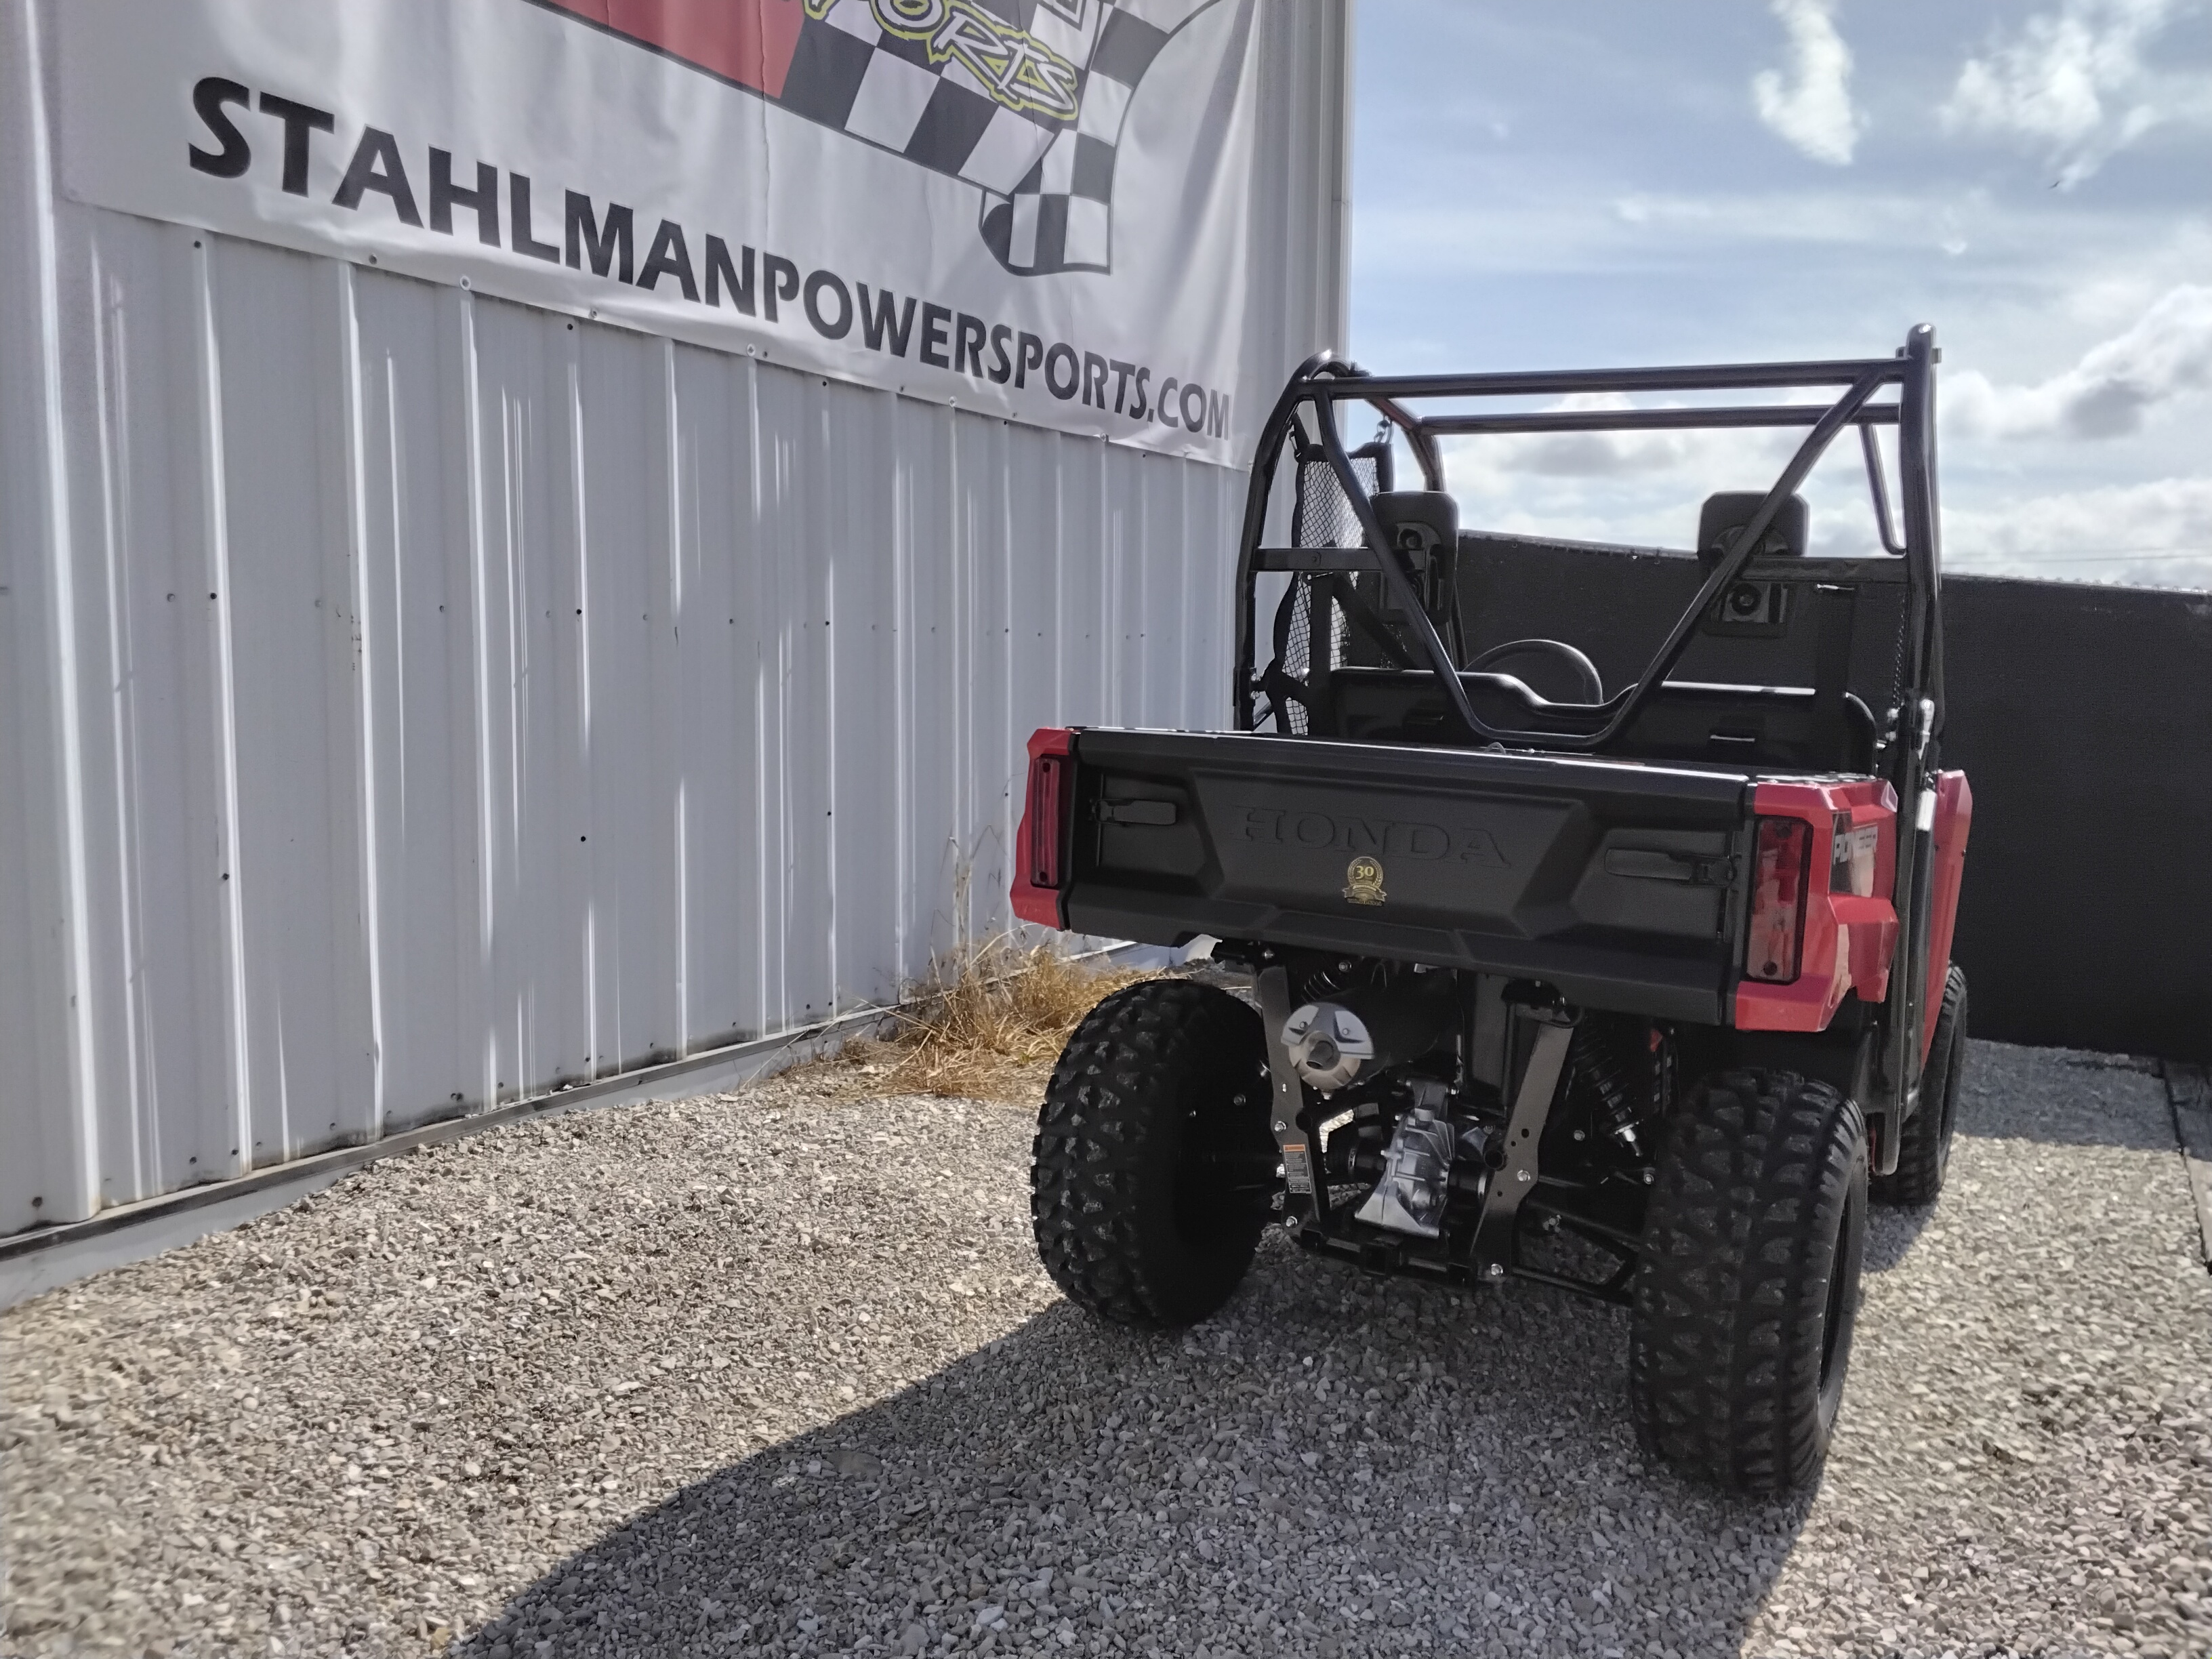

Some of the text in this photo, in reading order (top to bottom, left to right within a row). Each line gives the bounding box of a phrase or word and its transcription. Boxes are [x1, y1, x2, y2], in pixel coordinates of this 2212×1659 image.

[187, 75, 1231, 441] STAHLMANPOWERSPORTS.COM
[1231, 804, 1511, 869] HONDA
[1355, 865, 1374, 880] 30
